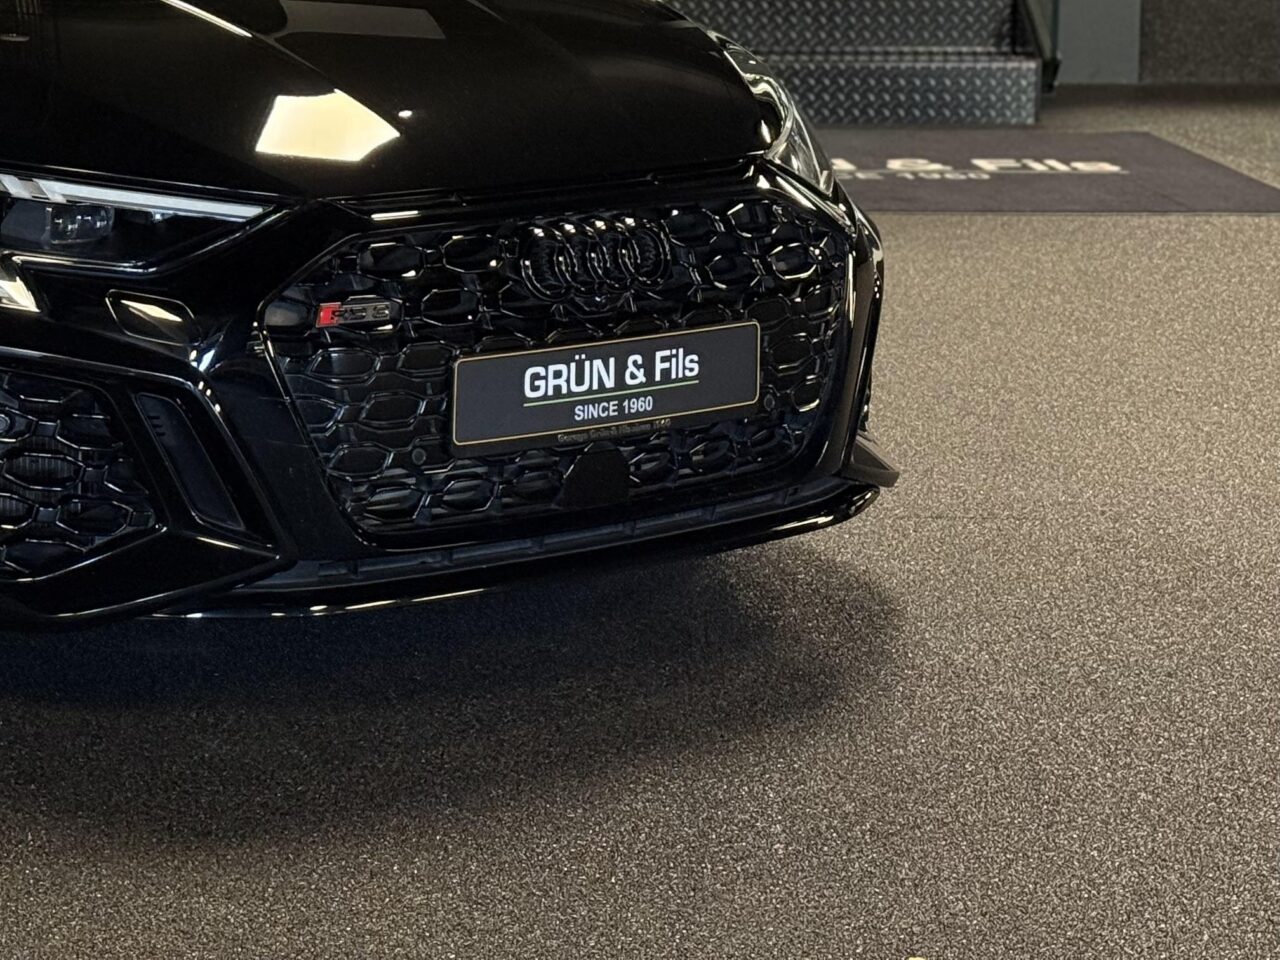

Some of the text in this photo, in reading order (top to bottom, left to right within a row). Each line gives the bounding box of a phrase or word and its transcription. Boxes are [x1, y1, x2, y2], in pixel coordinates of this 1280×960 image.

[887, 158, 952, 170] &
[524, 347, 700, 398] GRÜN & Fils
[574, 396, 653, 421] SINCE 1960
